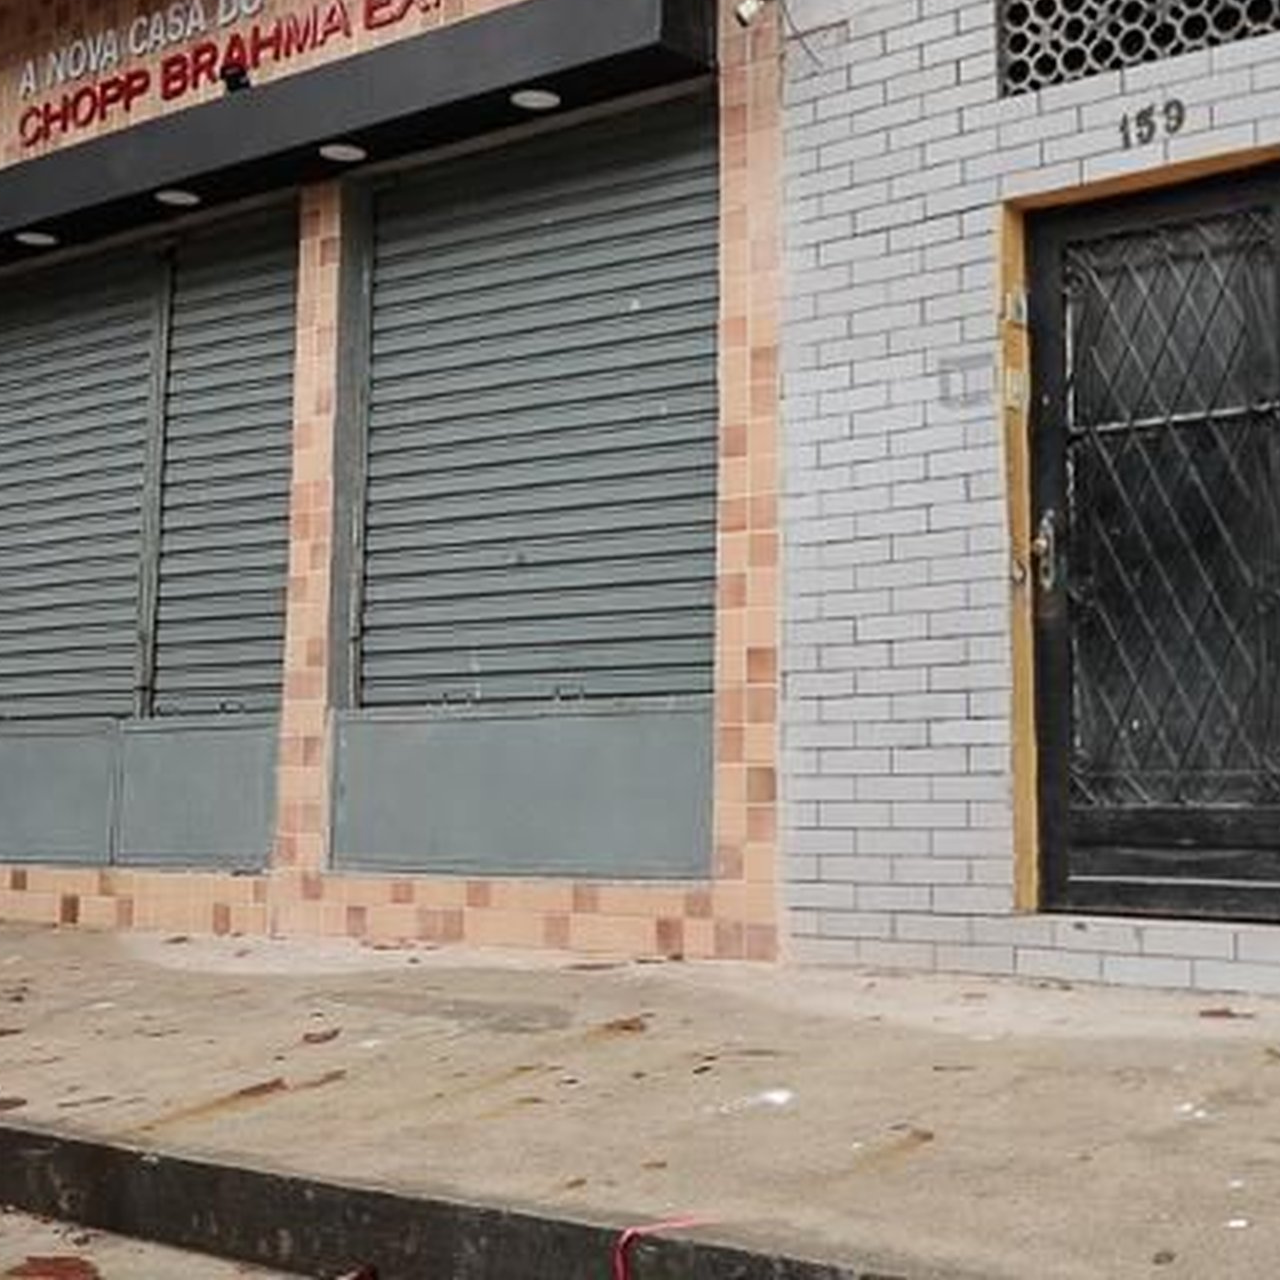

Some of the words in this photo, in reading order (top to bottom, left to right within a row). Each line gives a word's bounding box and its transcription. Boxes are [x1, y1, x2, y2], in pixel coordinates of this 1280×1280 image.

[19, 59, 36, 98] A
[46, 28, 120, 86] NOVA
[18, 69, 153, 149] CHOPP
[1119, 97, 1186, 151] 159
